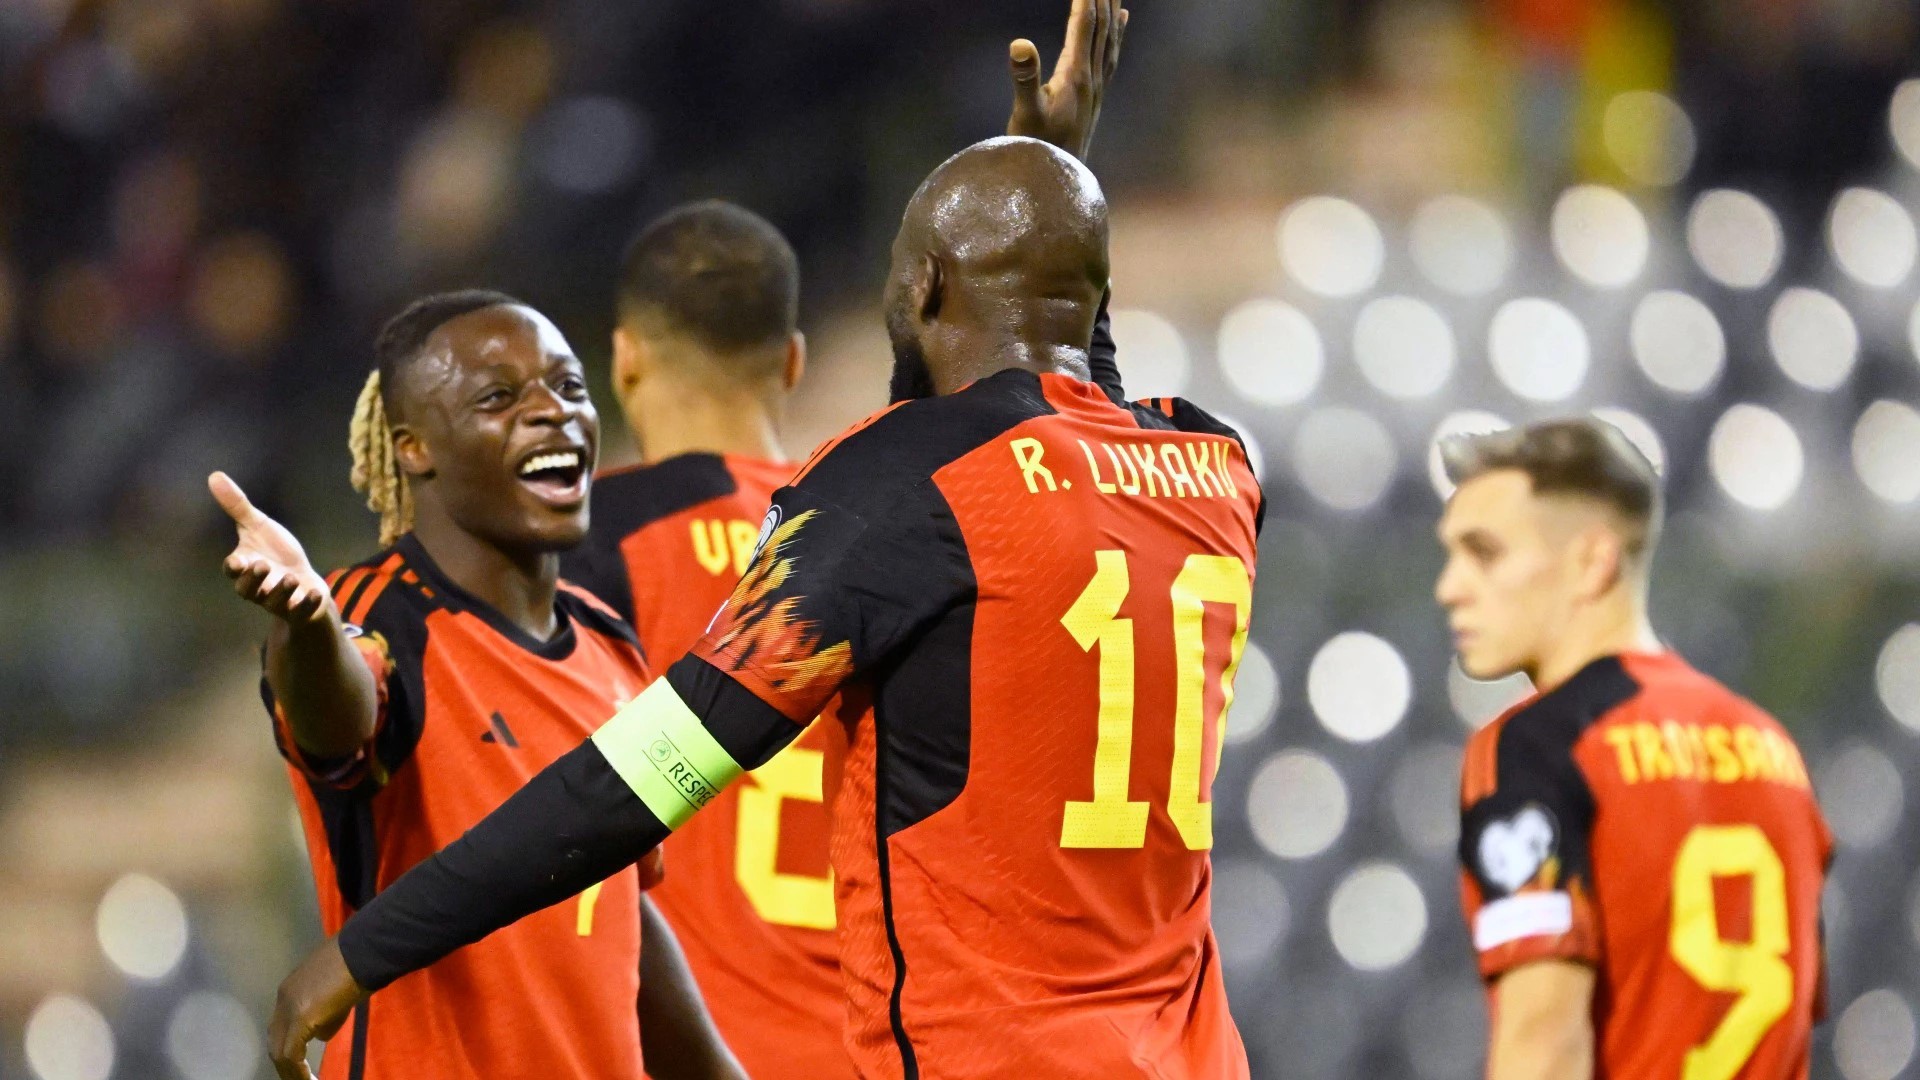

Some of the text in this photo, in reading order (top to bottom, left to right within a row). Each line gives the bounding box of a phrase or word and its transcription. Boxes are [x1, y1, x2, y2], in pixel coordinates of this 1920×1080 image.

[1010, 437, 1238, 499] R. LUKAKU
[1060, 550, 1251, 849] 10
[1669, 824, 1795, 1080] 9
